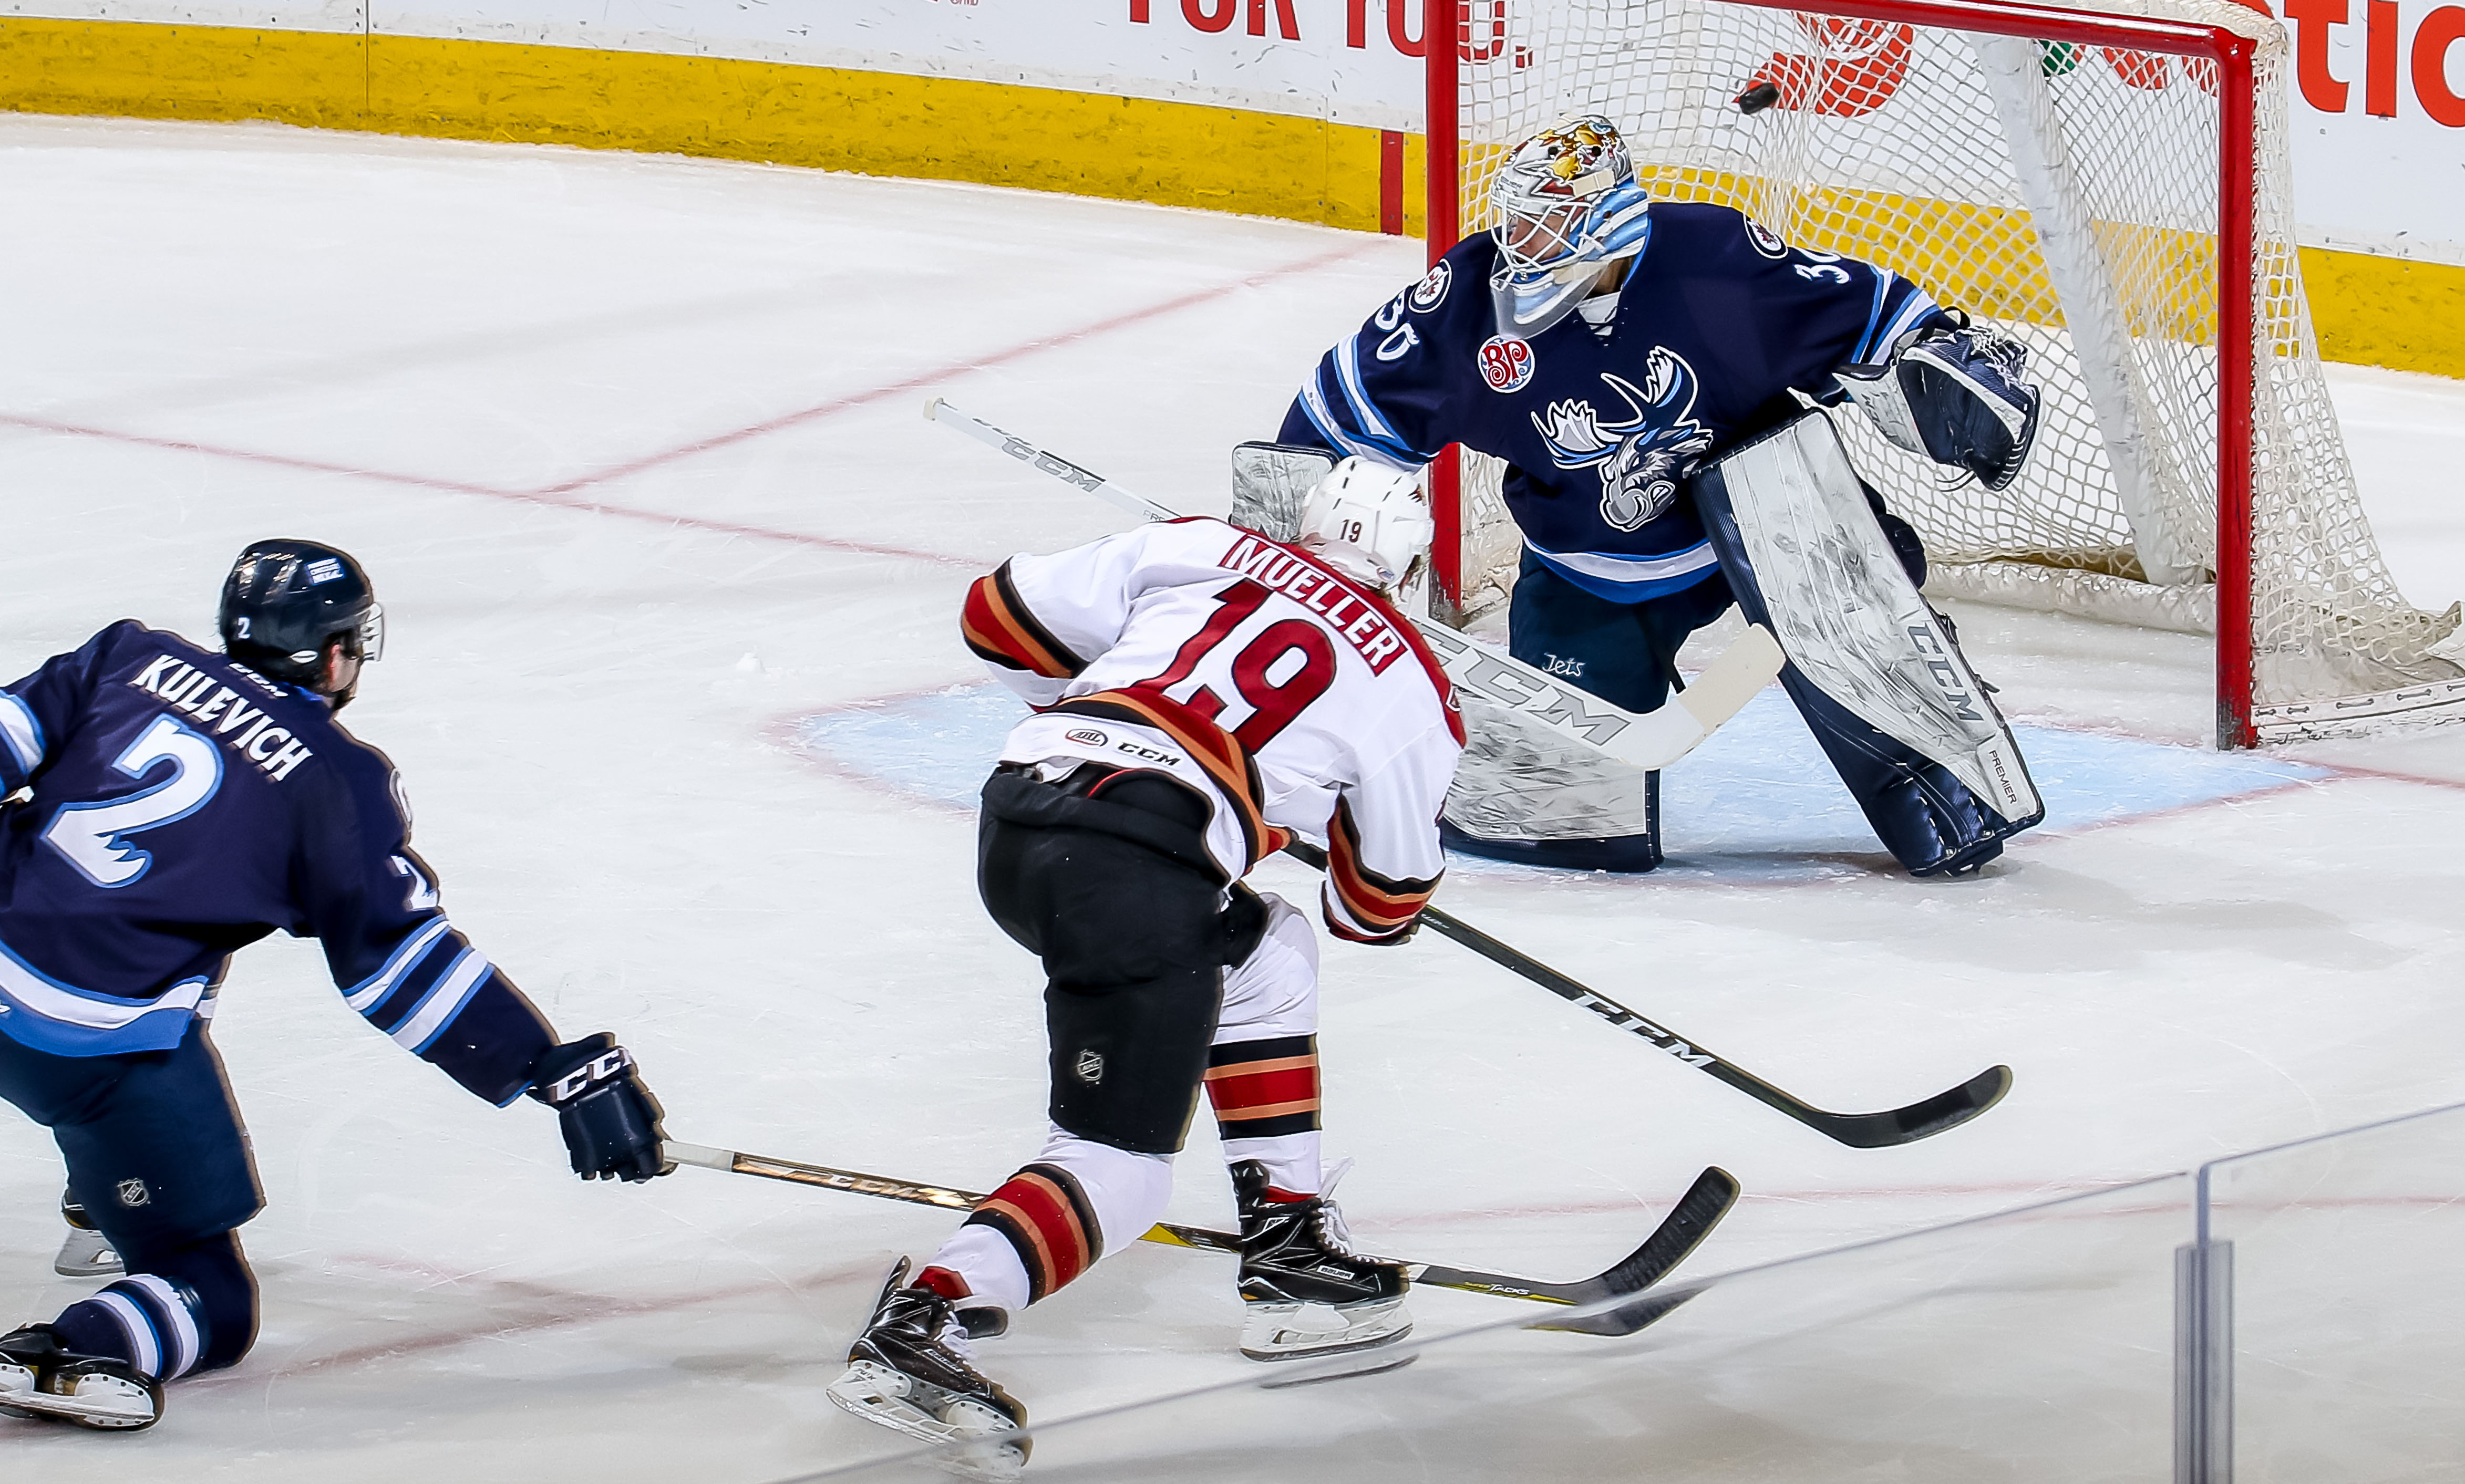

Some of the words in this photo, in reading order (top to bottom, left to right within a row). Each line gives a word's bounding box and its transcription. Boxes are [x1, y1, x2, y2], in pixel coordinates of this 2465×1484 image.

[1375, 288, 1420, 361] 30
[1482, 340, 1528, 388] BP
[1001, 437, 1102, 493] CCM
[1339, 518, 1362, 543] 19
[238, 616, 251, 639] 2
[1224, 537, 1401, 668] MUELLER
[1135, 576, 1337, 755] 19
[1542, 653, 1586, 677] Jets
[1906, 622, 1984, 722] CCM
[131, 654, 314, 782] KULEVICH
[1117, 742, 1181, 766] CCM
[1989, 749, 2018, 805] PREMIER
[39, 712, 225, 889] 2
[390, 855, 438, 911] 2
[1572, 990, 1717, 1068] CCM
